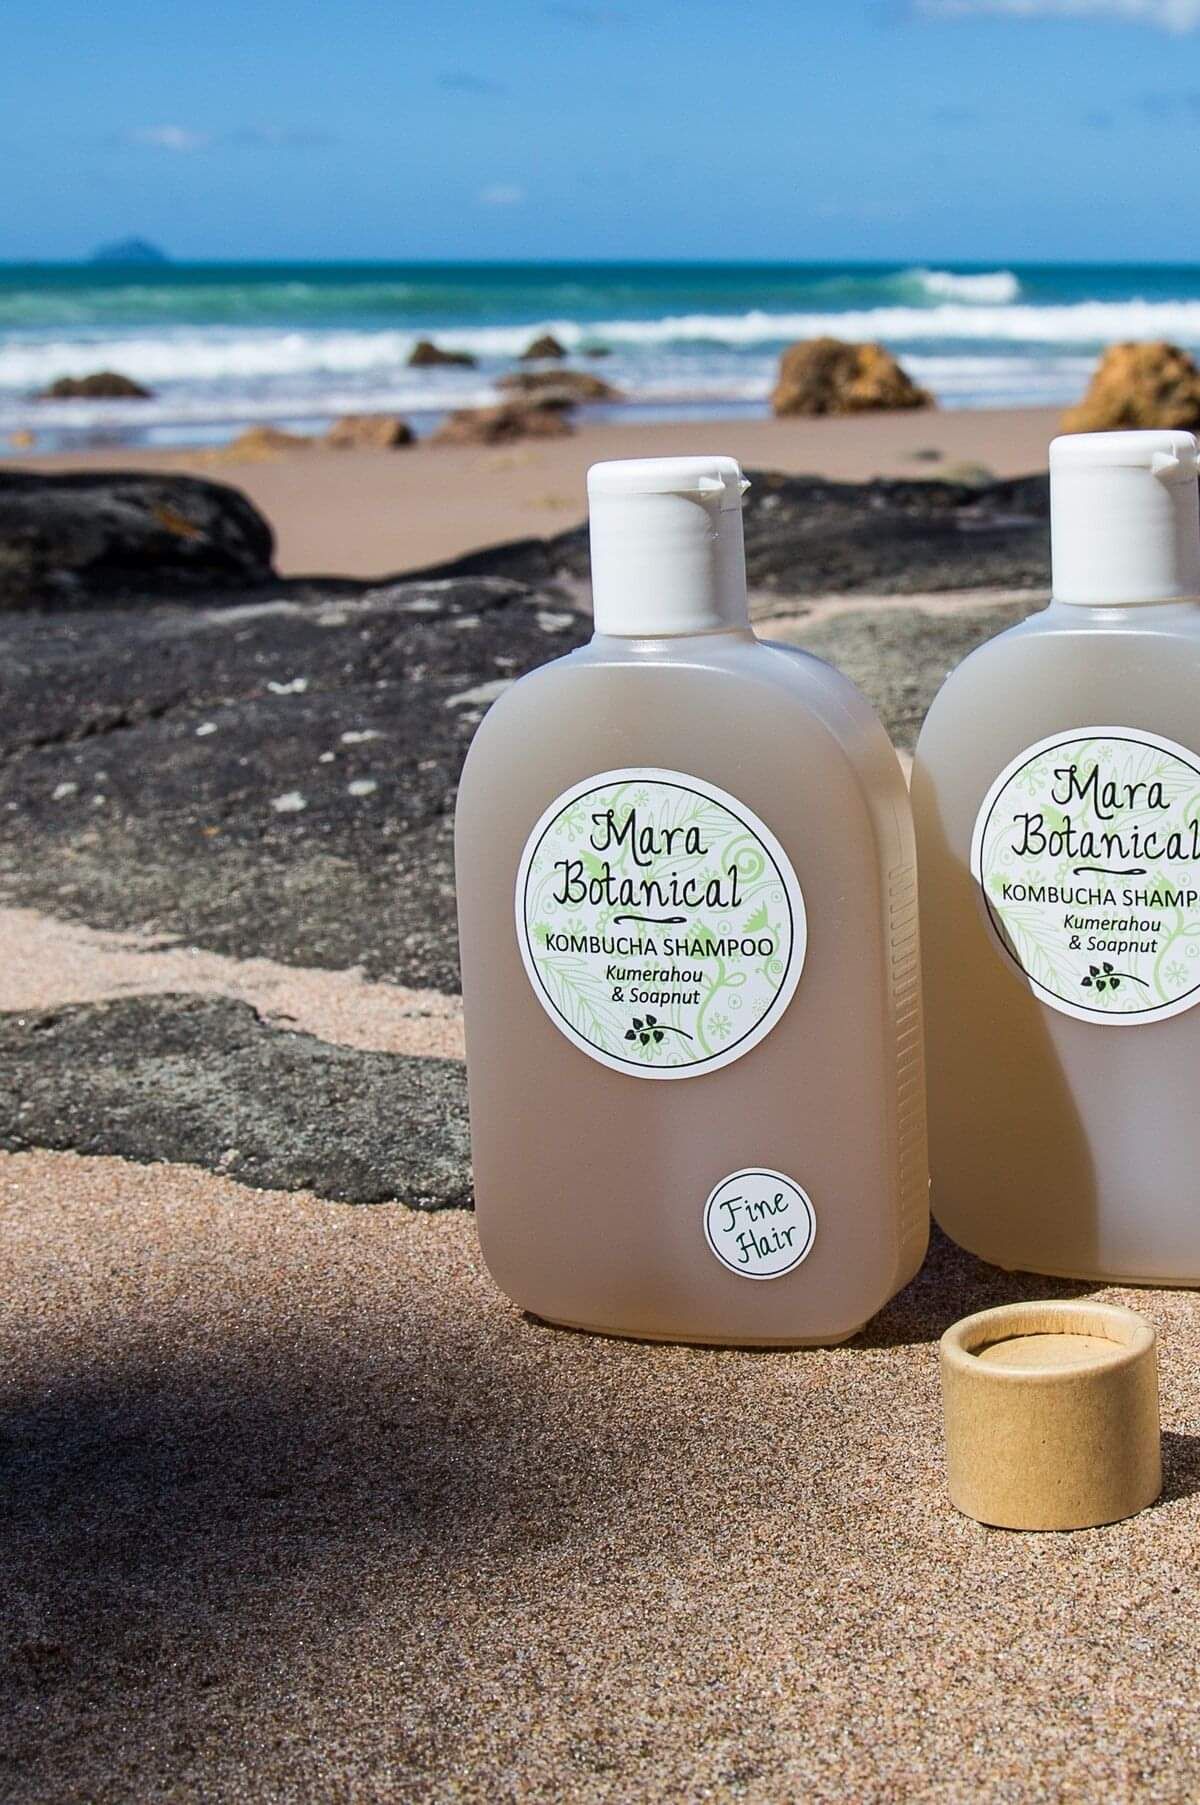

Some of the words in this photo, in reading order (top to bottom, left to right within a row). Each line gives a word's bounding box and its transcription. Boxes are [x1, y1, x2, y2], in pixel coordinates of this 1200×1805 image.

[1052, 764, 1170, 820] Mara
[590, 809, 708, 866] Mara
[553, 859, 742, 907] Botanical
[1002, 883, 1117, 906] KOMBUCHA
[1064, 914, 1161, 932] Kumerahou
[546, 934, 656, 956] KOMBUCHA
[663, 937, 774, 957] SHAMPOO
[1069, 935, 1081, 950] &
[1087, 936, 1158, 955] Soapnut
[606, 964, 703, 983] Kumerahou
[611, 986, 625, 1002] &
[629, 987, 700, 1007] Soapnut
[720, 1193, 788, 1232] Fine
[736, 1226, 796, 1263] Hair
